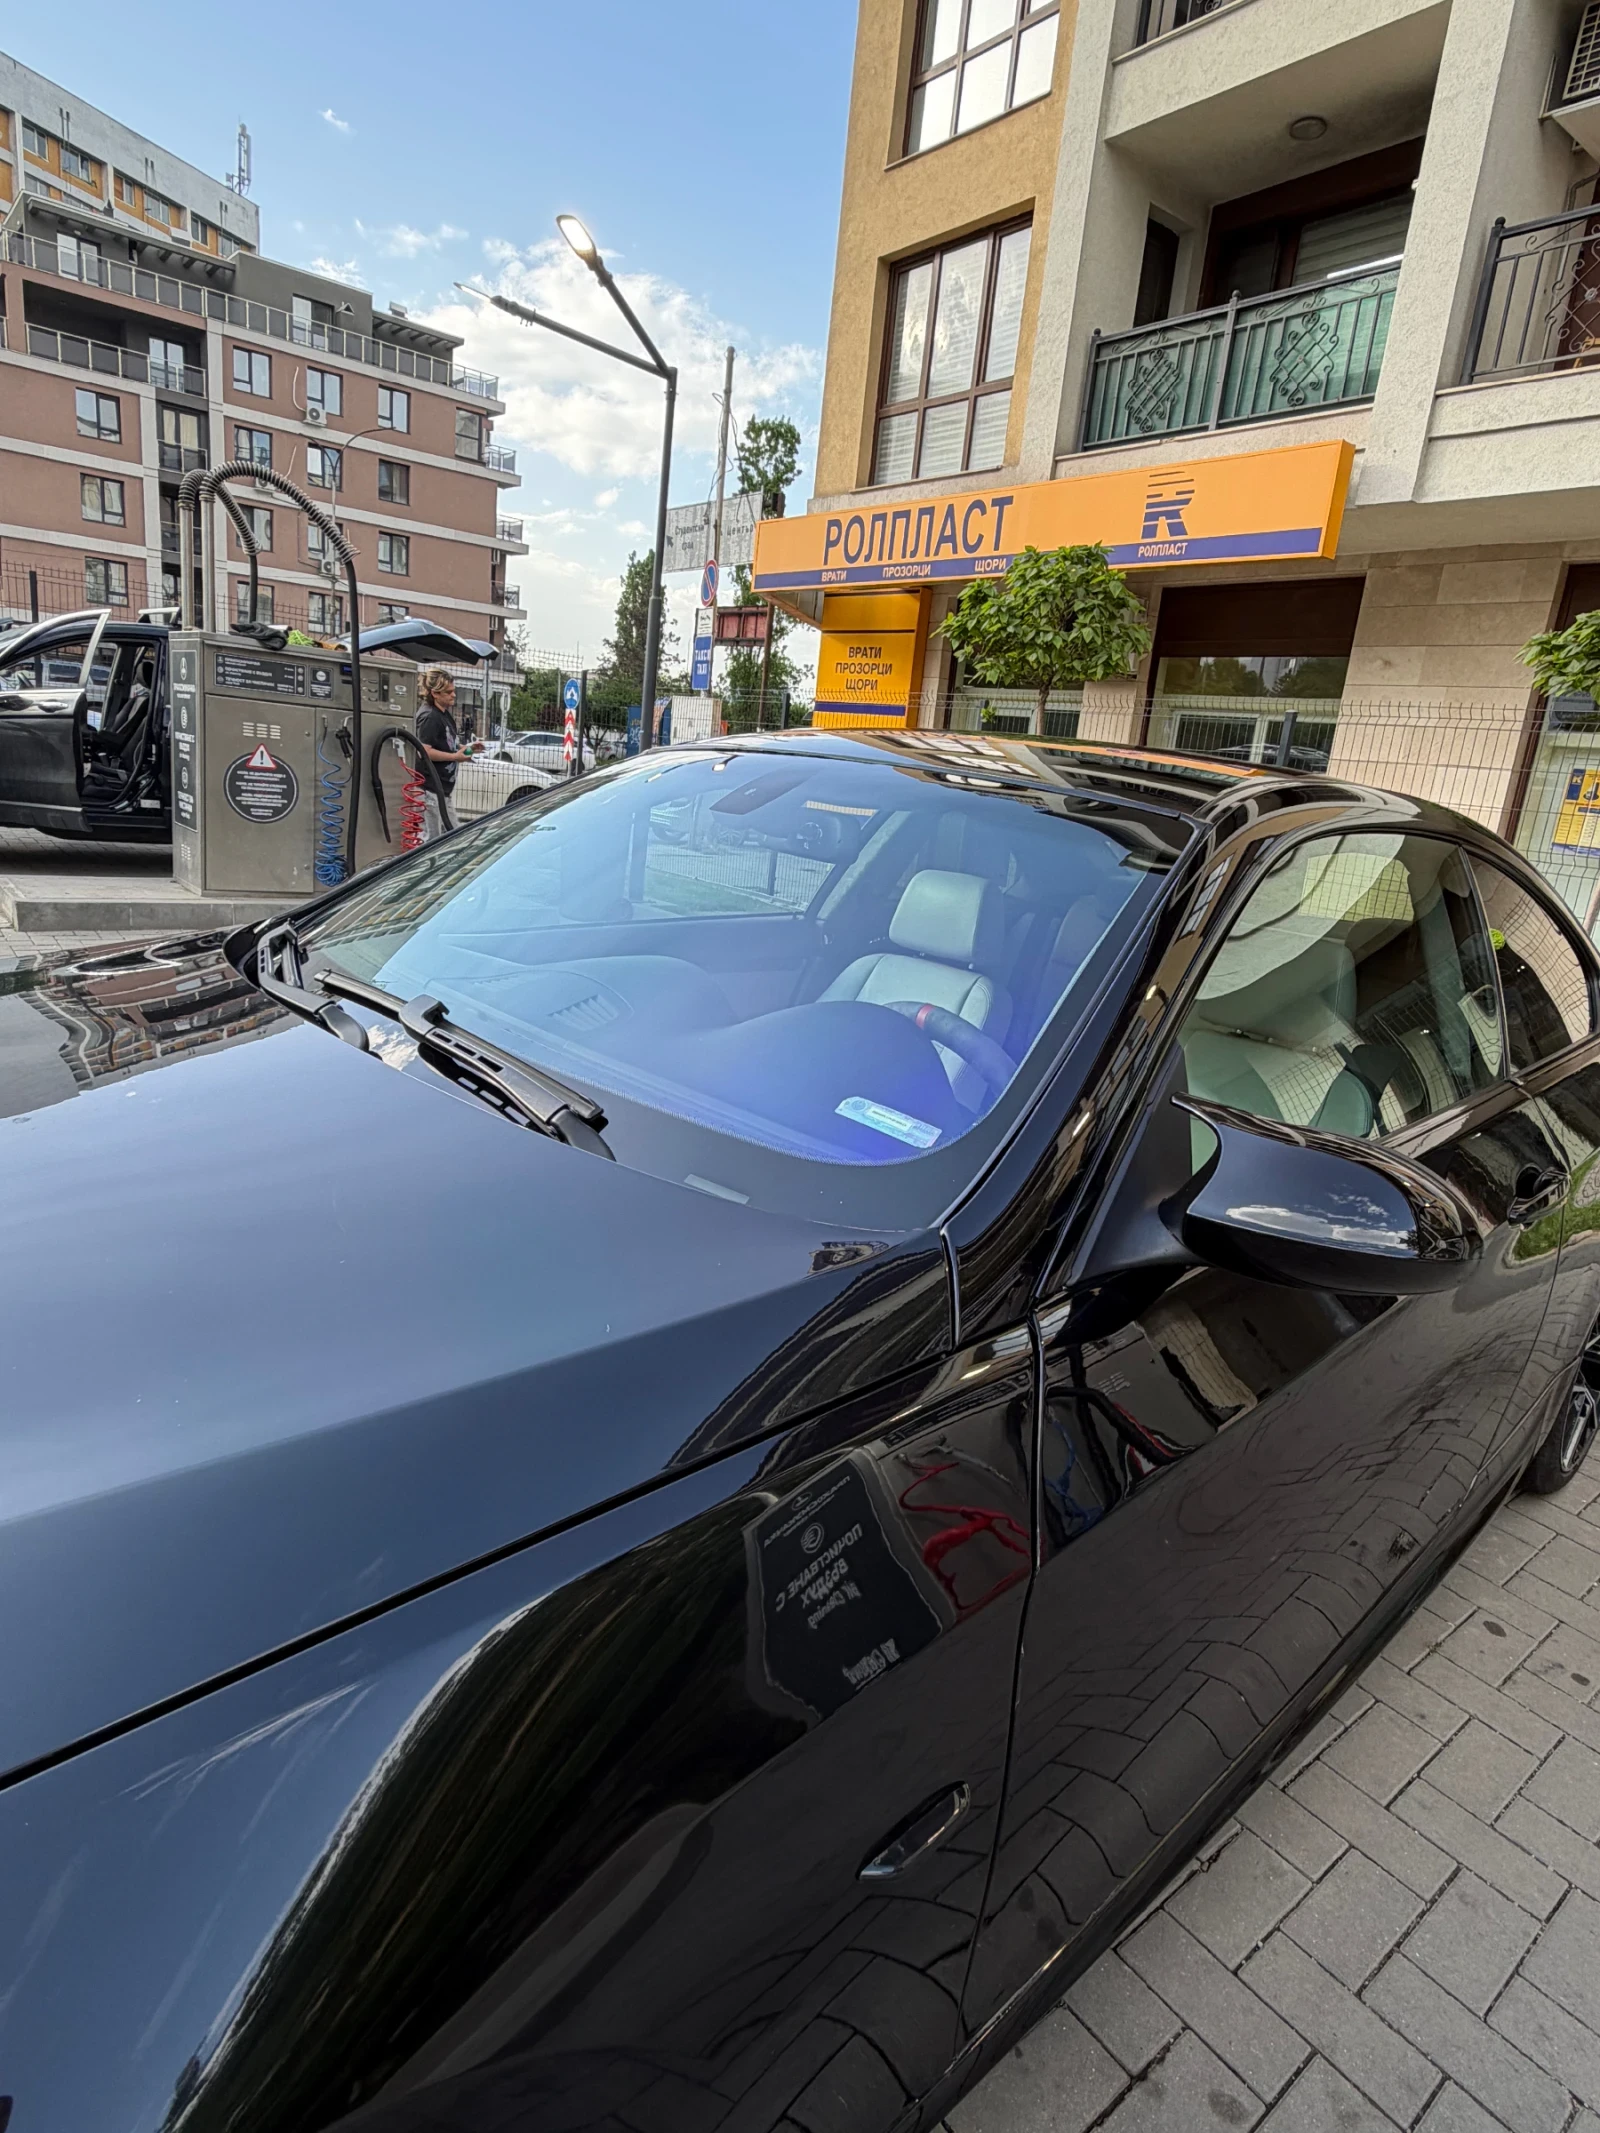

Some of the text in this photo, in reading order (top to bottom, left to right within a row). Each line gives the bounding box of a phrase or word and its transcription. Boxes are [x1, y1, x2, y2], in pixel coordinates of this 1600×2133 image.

[823, 495, 1014, 566] РОЛПЛАСТ
[1137, 542, 1189, 558] РОЛПЛАСТ
[821, 557, 1006, 582] ВРАТИ ПРОЗОРЦИ ЩОРИ
[848, 646, 882, 659] ВРАТИ
[835, 662, 893, 676] ПРОЗОРЦИ
[845, 678, 878, 691] ЩОРИ
